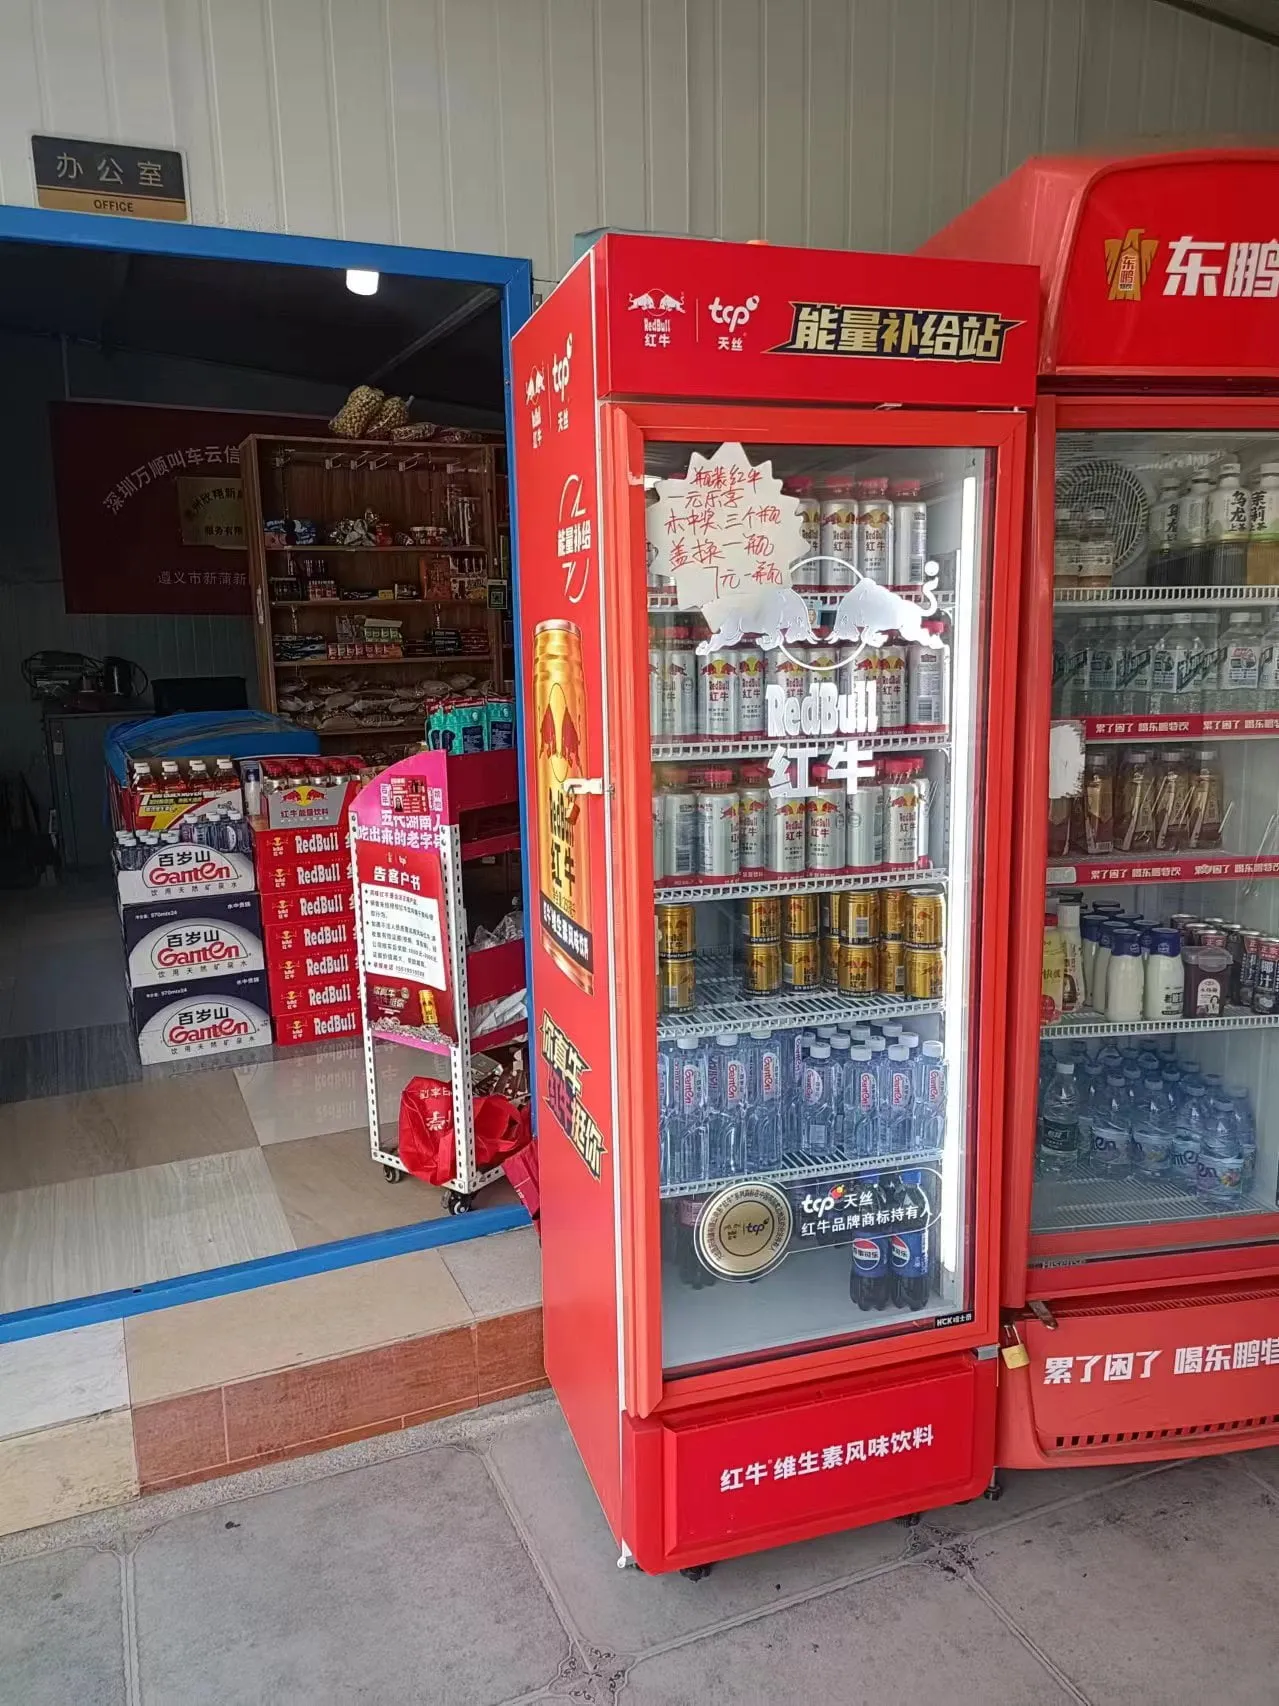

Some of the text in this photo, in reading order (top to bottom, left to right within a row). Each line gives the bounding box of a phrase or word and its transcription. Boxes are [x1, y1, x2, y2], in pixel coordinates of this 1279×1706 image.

[56, 151, 165, 189] 办公室
[93, 198, 135, 213] OFFICE
[1163, 235, 1279, 298] 东鹏
[643, 317, 671, 333] RedBull
[708, 296, 752, 334] tcp
[644, 333, 671, 348] 红牛
[717, 336, 743, 352] 天丝
[792, 306, 1004, 360] 能量补给站
[102, 445, 241, 516] 深圳万顺叫车云信
[689, 464, 764, 494] 瓶装红牛
[667, 488, 744, 509] 一元乐享
[1228, 490, 1247, 523] 乌龙
[1250, 490, 1268, 523] 茉莉
[557, 519, 591, 558] 能量补给
[833, 541, 853, 552] 红牛
[865, 541, 886, 552] 红牛
[668, 532, 774, 572] 盖换一瓶
[158, 570, 247, 587] 遵义市新蒲新
[709, 692, 729, 702] 红牛
[765, 680, 878, 738] RedBull
[1096, 722, 1134, 734] 累了困了
[1203, 719, 1241, 731] 累了困了
[767, 740, 876, 799] 红牛
[295, 831, 339, 854] RedBull
[158, 850, 211, 867] 百岁山
[550, 840, 576, 897] 红牛
[149, 860, 231, 888] Ganten
[297, 863, 341, 885] RedBull
[373, 866, 421, 891] 告客户书
[300, 894, 344, 917] RedBull
[166, 928, 220, 948] 百岁山
[304, 924, 347, 947] RedBull
[157, 941, 240, 968] Ganten
[306, 954, 350, 977] RedBull
[308, 984, 351, 1007] RedBull
[178, 1006, 230, 1026] 百岁山
[313, 1012, 357, 1036] RedBull
[168, 1018, 249, 1044] Ganten
[800, 1191, 874, 1218] tcp 天丝
[800, 1203, 934, 1238] 红牛品牌商标持有人
[1043, 1349, 1163, 1385] 累了困了
[720, 1423, 934, 1492] 红牛维生素风味饮料
